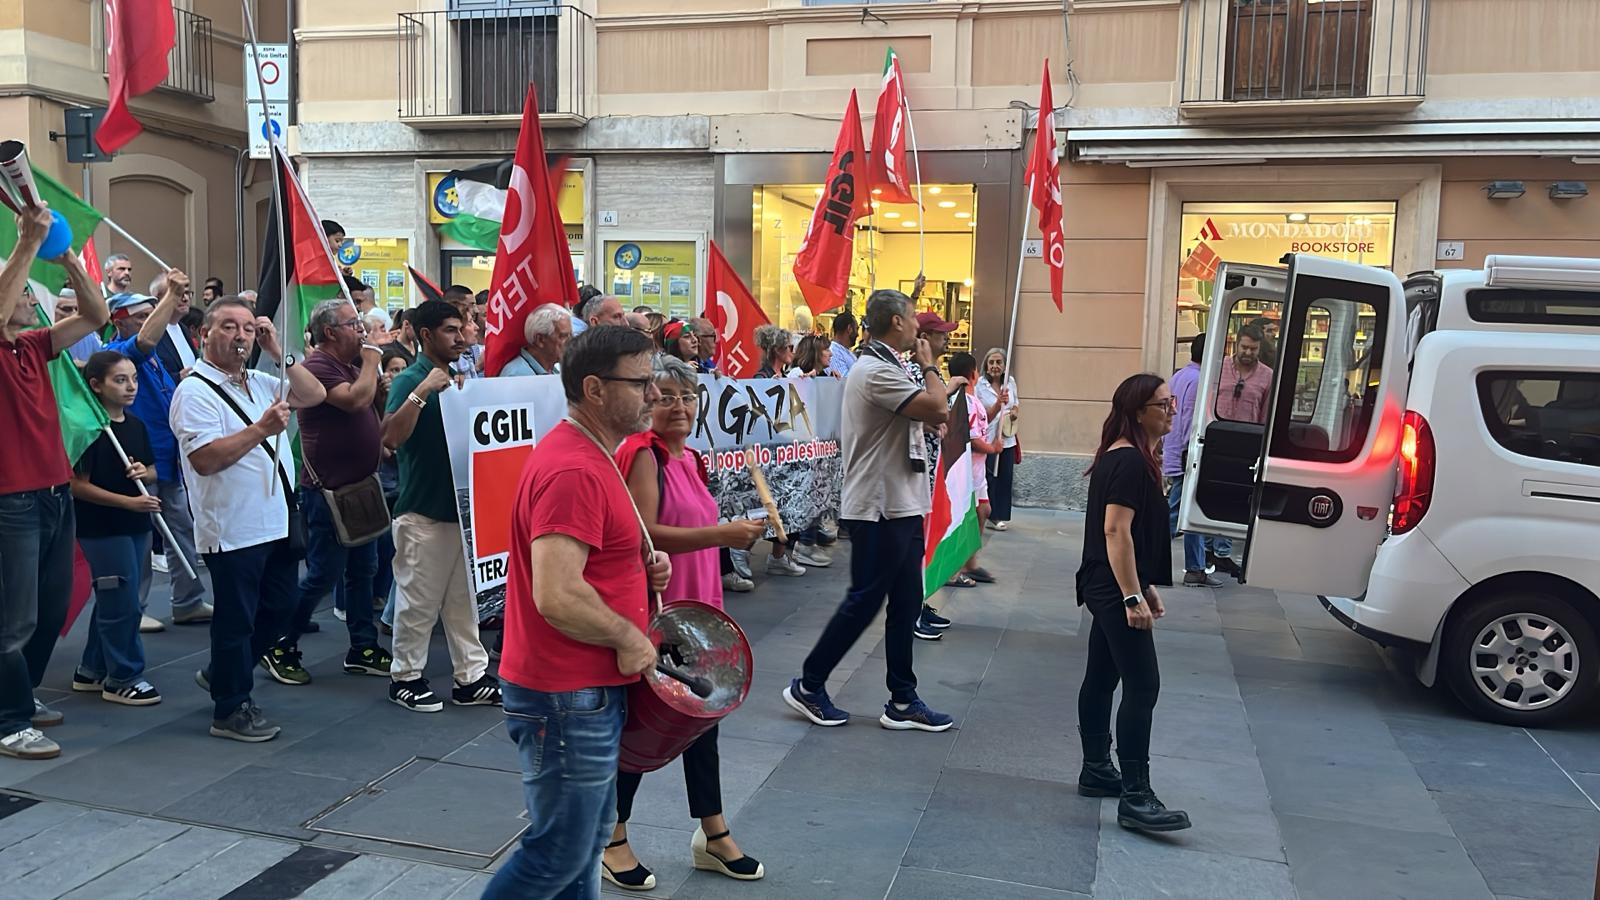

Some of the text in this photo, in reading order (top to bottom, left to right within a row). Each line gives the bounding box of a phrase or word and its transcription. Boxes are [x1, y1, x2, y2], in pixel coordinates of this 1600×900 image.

[1225, 222, 1373, 239] MONDADORI
[1026, 246, 1037, 254] 65
[1291, 242, 1375, 253] BOOKSTORE
[1444, 248, 1457, 257] 67
[718, 383, 814, 445] GAZA
[473, 408, 533, 446] CGIL
[699, 437, 838, 477] el popolo palestinese
[1313, 502, 1330, 515] FIAT
